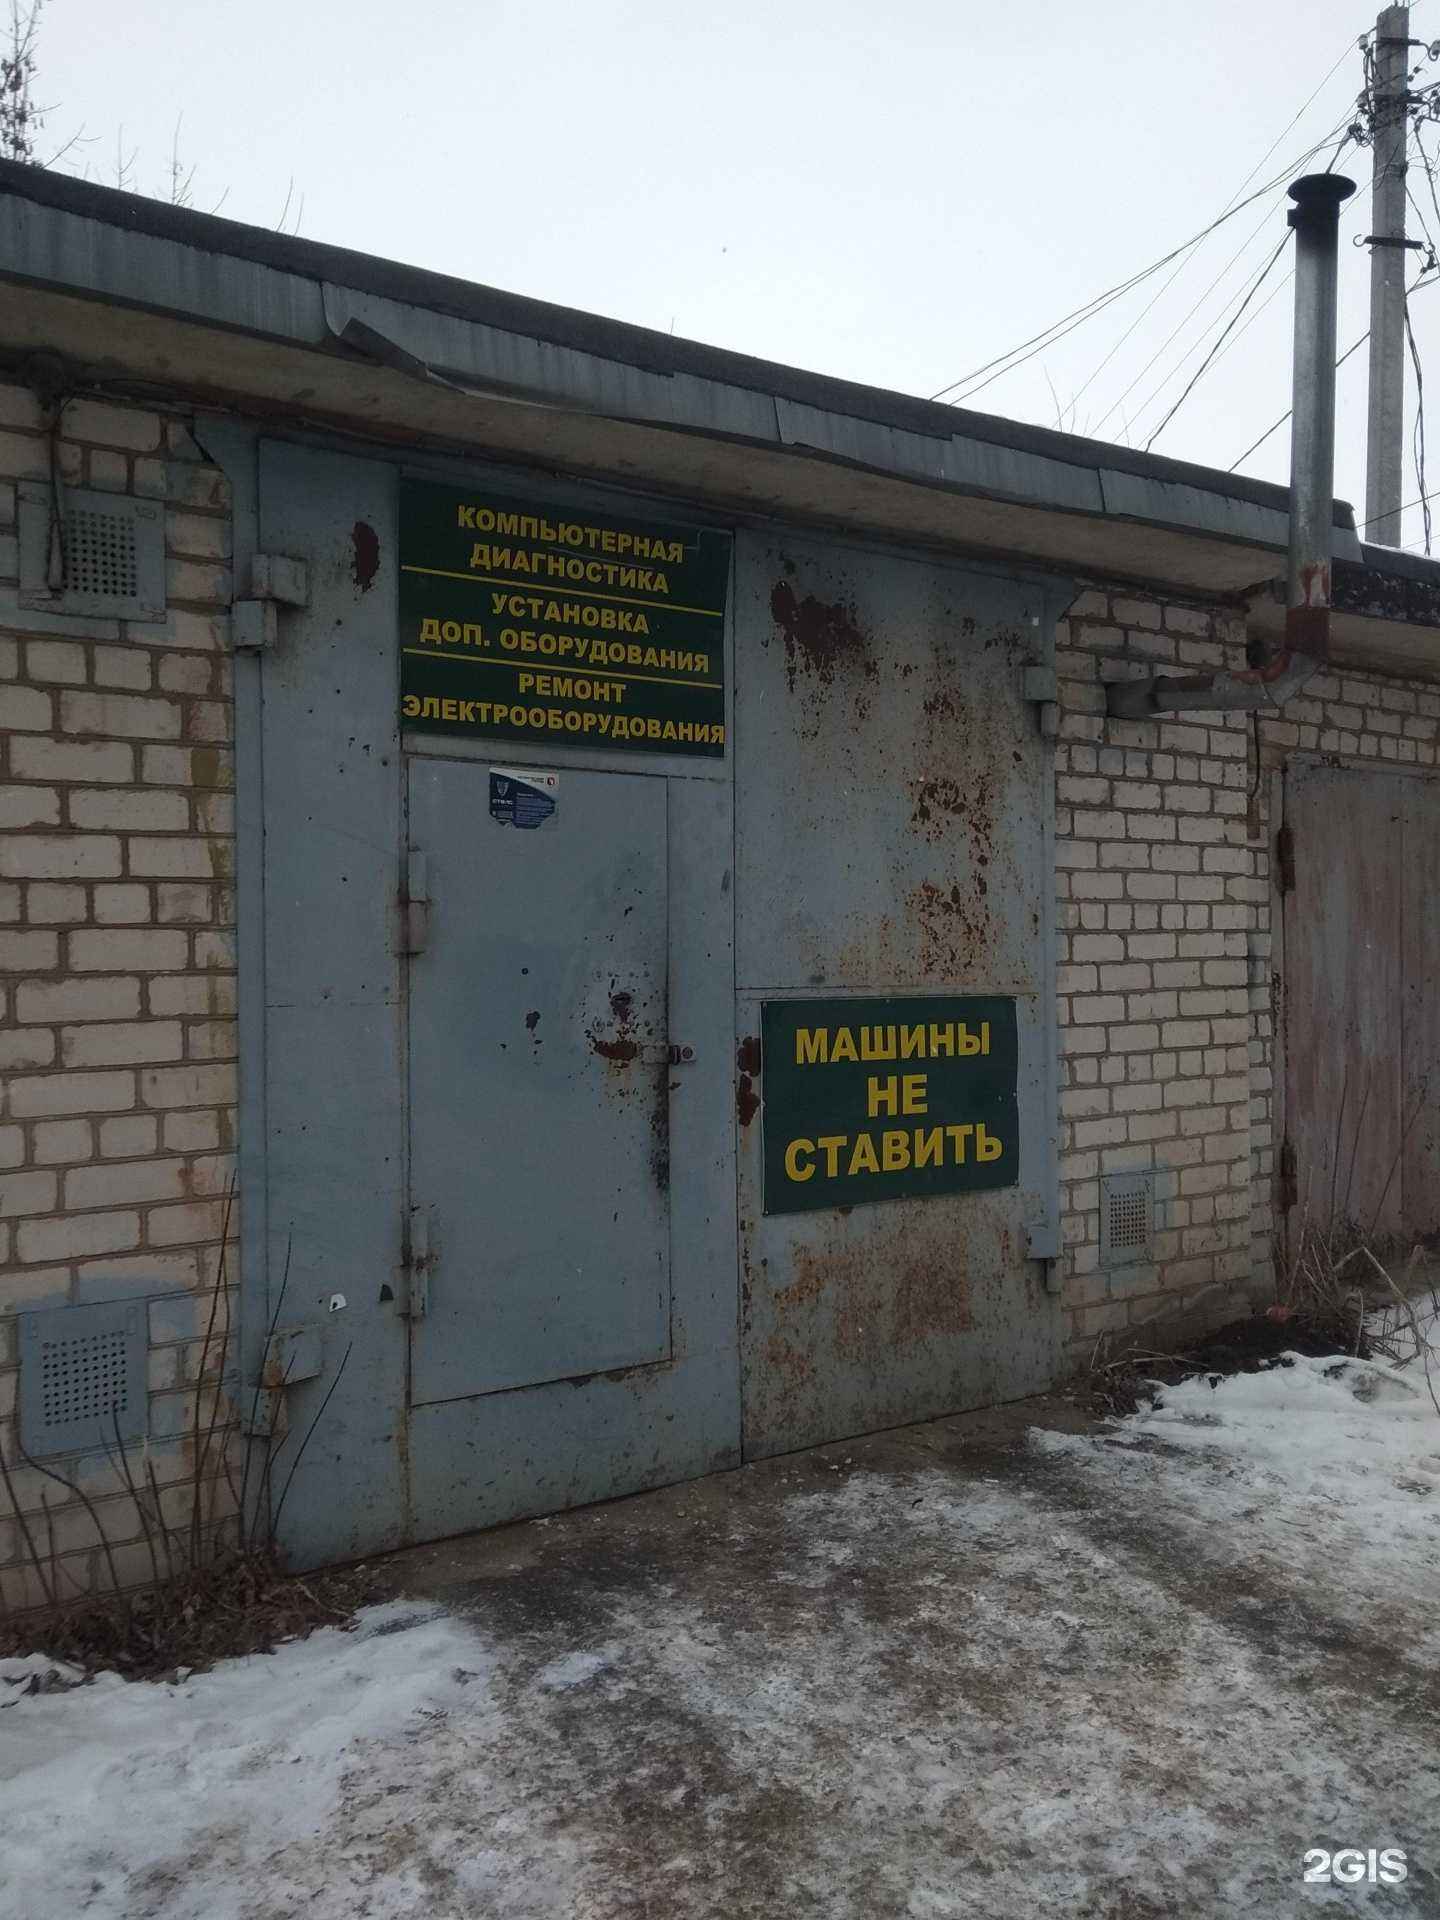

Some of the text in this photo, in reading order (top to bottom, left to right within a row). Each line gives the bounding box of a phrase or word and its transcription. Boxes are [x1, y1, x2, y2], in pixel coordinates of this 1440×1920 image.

[458, 505, 684, 563] КОМПЬЮТЕРНАЯ
[470, 543, 670, 594] ДИАГНОСТИКА
[491, 593, 650, 634] УСТАНОВКА
[419, 618, 709, 673] ДОП. ОБОРУДОВАНИЯ
[519, 673, 626, 703] РЕМОНТ
[402, 695, 725, 744] ЭЛЕКТРООБОРУДОВАНИЯ
[796, 1022, 990, 1065] МАШИНЫ
[868, 1074, 928, 1117] НЕ
[785, 1123, 1003, 1182] СТАВИТЬ
